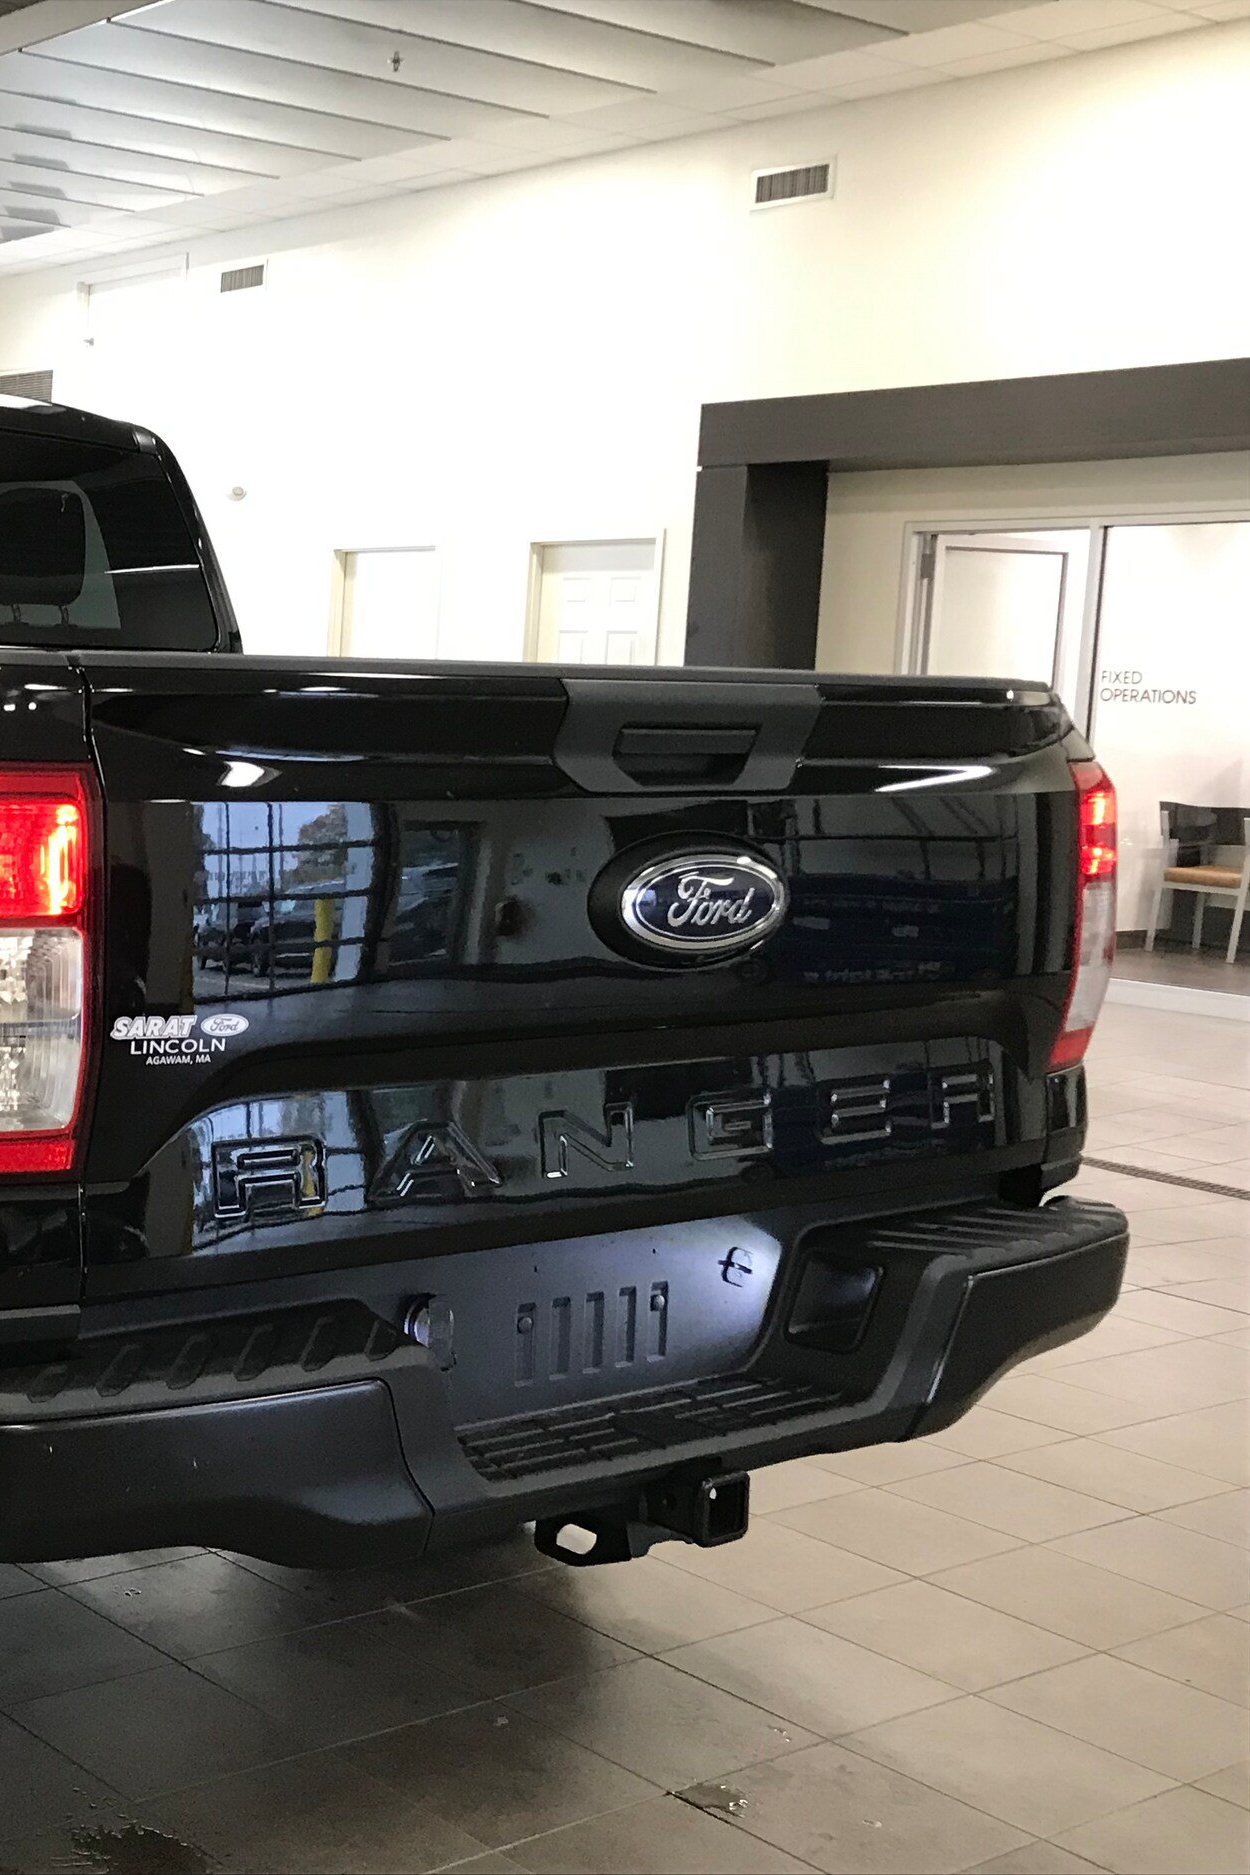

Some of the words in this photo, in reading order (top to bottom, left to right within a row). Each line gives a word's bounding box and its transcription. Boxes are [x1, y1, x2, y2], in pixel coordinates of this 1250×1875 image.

[1101, 670, 1143, 685] FIXED
[1100, 687, 1197, 704] OPERATIONS
[667, 871, 755, 927] Ford
[111, 1014, 197, 1040] SARAT
[209, 1018, 240, 1034] Ford
[130, 1038, 226, 1055] LINCOLN
[146, 1055, 193, 1066] AGAWAM,
[195, 1054, 211, 1064] MA
[211, 1065, 995, 1220] RANGER
